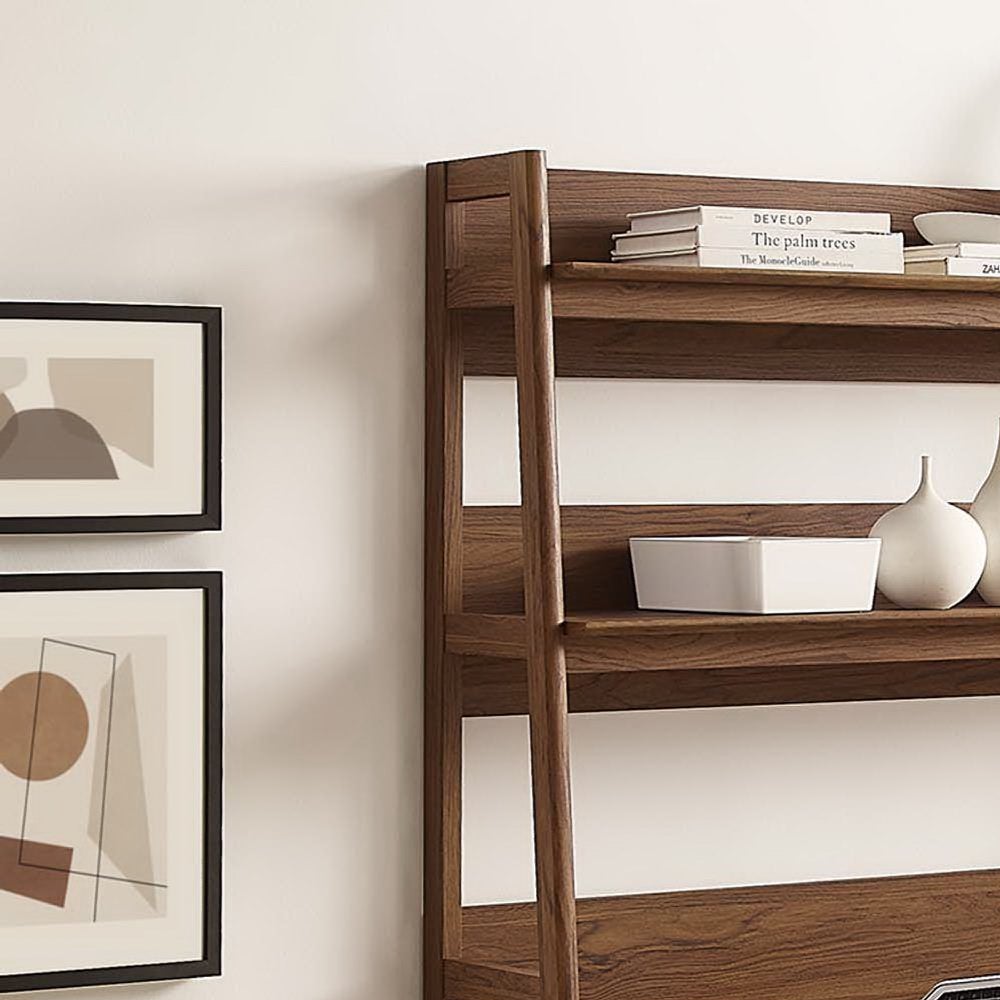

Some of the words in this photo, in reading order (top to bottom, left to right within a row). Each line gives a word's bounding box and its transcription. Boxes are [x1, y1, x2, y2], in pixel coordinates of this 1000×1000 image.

[753, 213, 812, 225] DEVELOP
[751, 232, 780, 246] The
[784, 234, 818, 251] palm
[822, 238, 856, 250] trees
